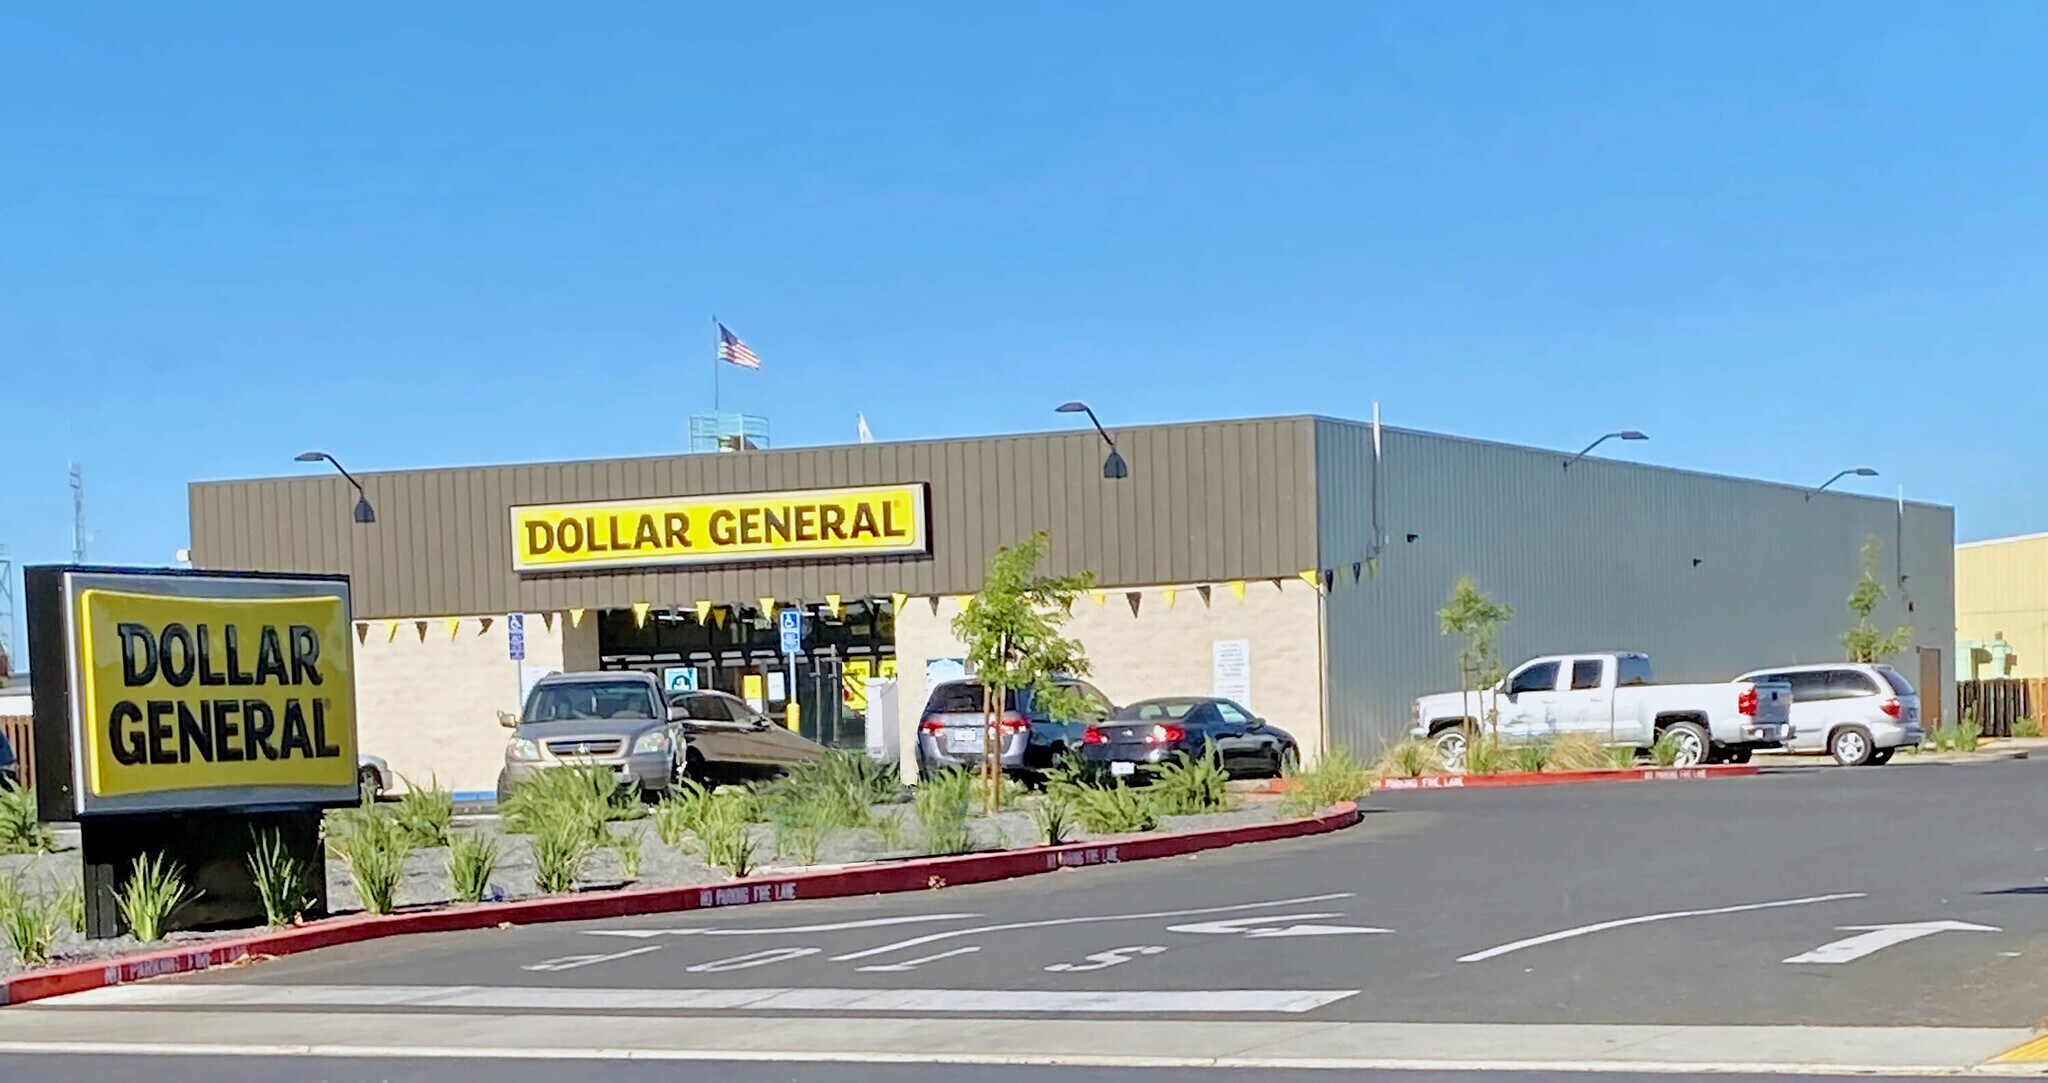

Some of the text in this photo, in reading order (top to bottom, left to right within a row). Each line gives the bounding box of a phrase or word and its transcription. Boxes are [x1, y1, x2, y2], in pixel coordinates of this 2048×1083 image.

[525, 500, 907, 555] DOLLAR GENERAL
[117, 622, 324, 688] DOLLAR
[109, 698, 340, 765] GENERAL
